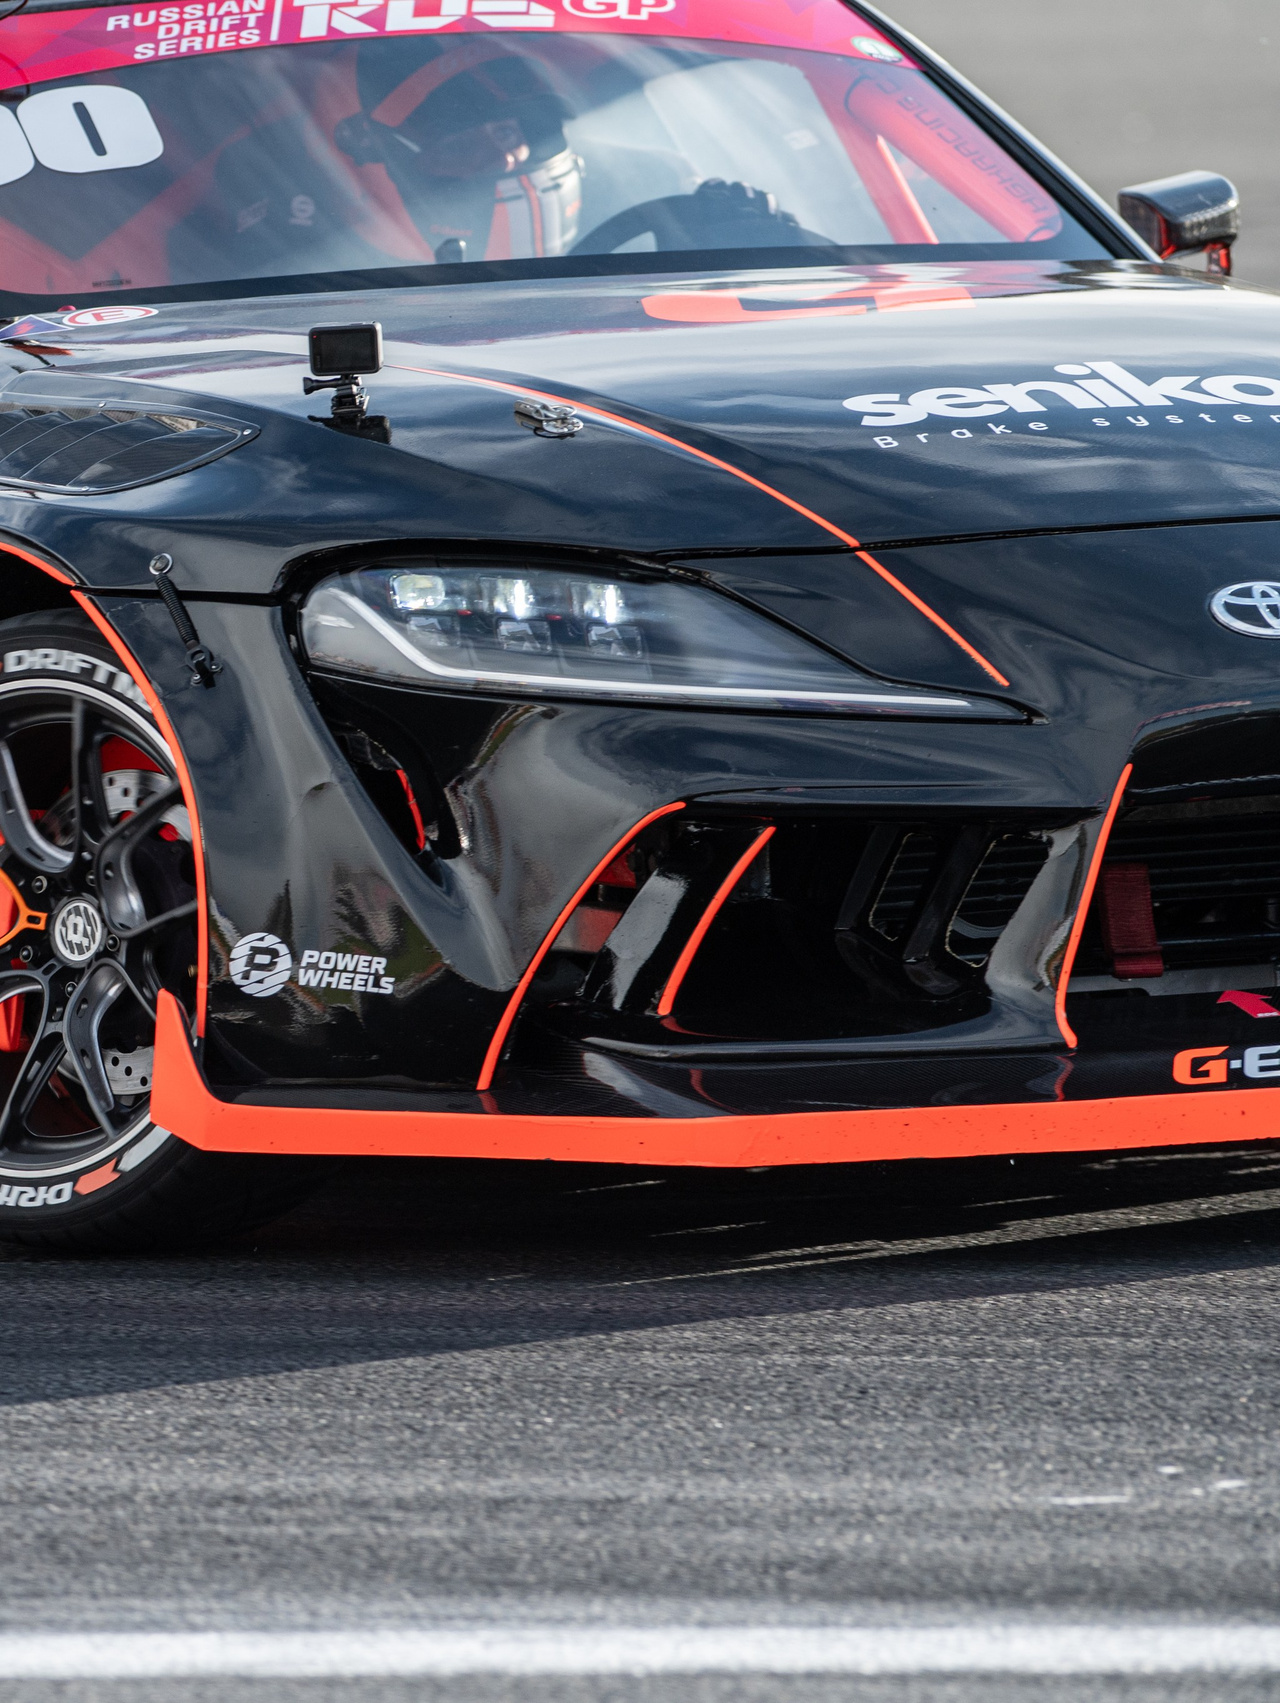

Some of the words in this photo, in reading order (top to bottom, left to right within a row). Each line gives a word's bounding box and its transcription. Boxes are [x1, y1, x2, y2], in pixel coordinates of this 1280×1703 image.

[106, 0, 267, 32] RUSSIAN
[157, 12, 265, 40] DRIFT
[133, 28, 261, 60] SERIES
[842, 361, 1280, 427] seniko
[872, 412, 1049, 449] Brake
[300, 950, 387, 975] POWER
[298, 968, 396, 995] WHEELS
